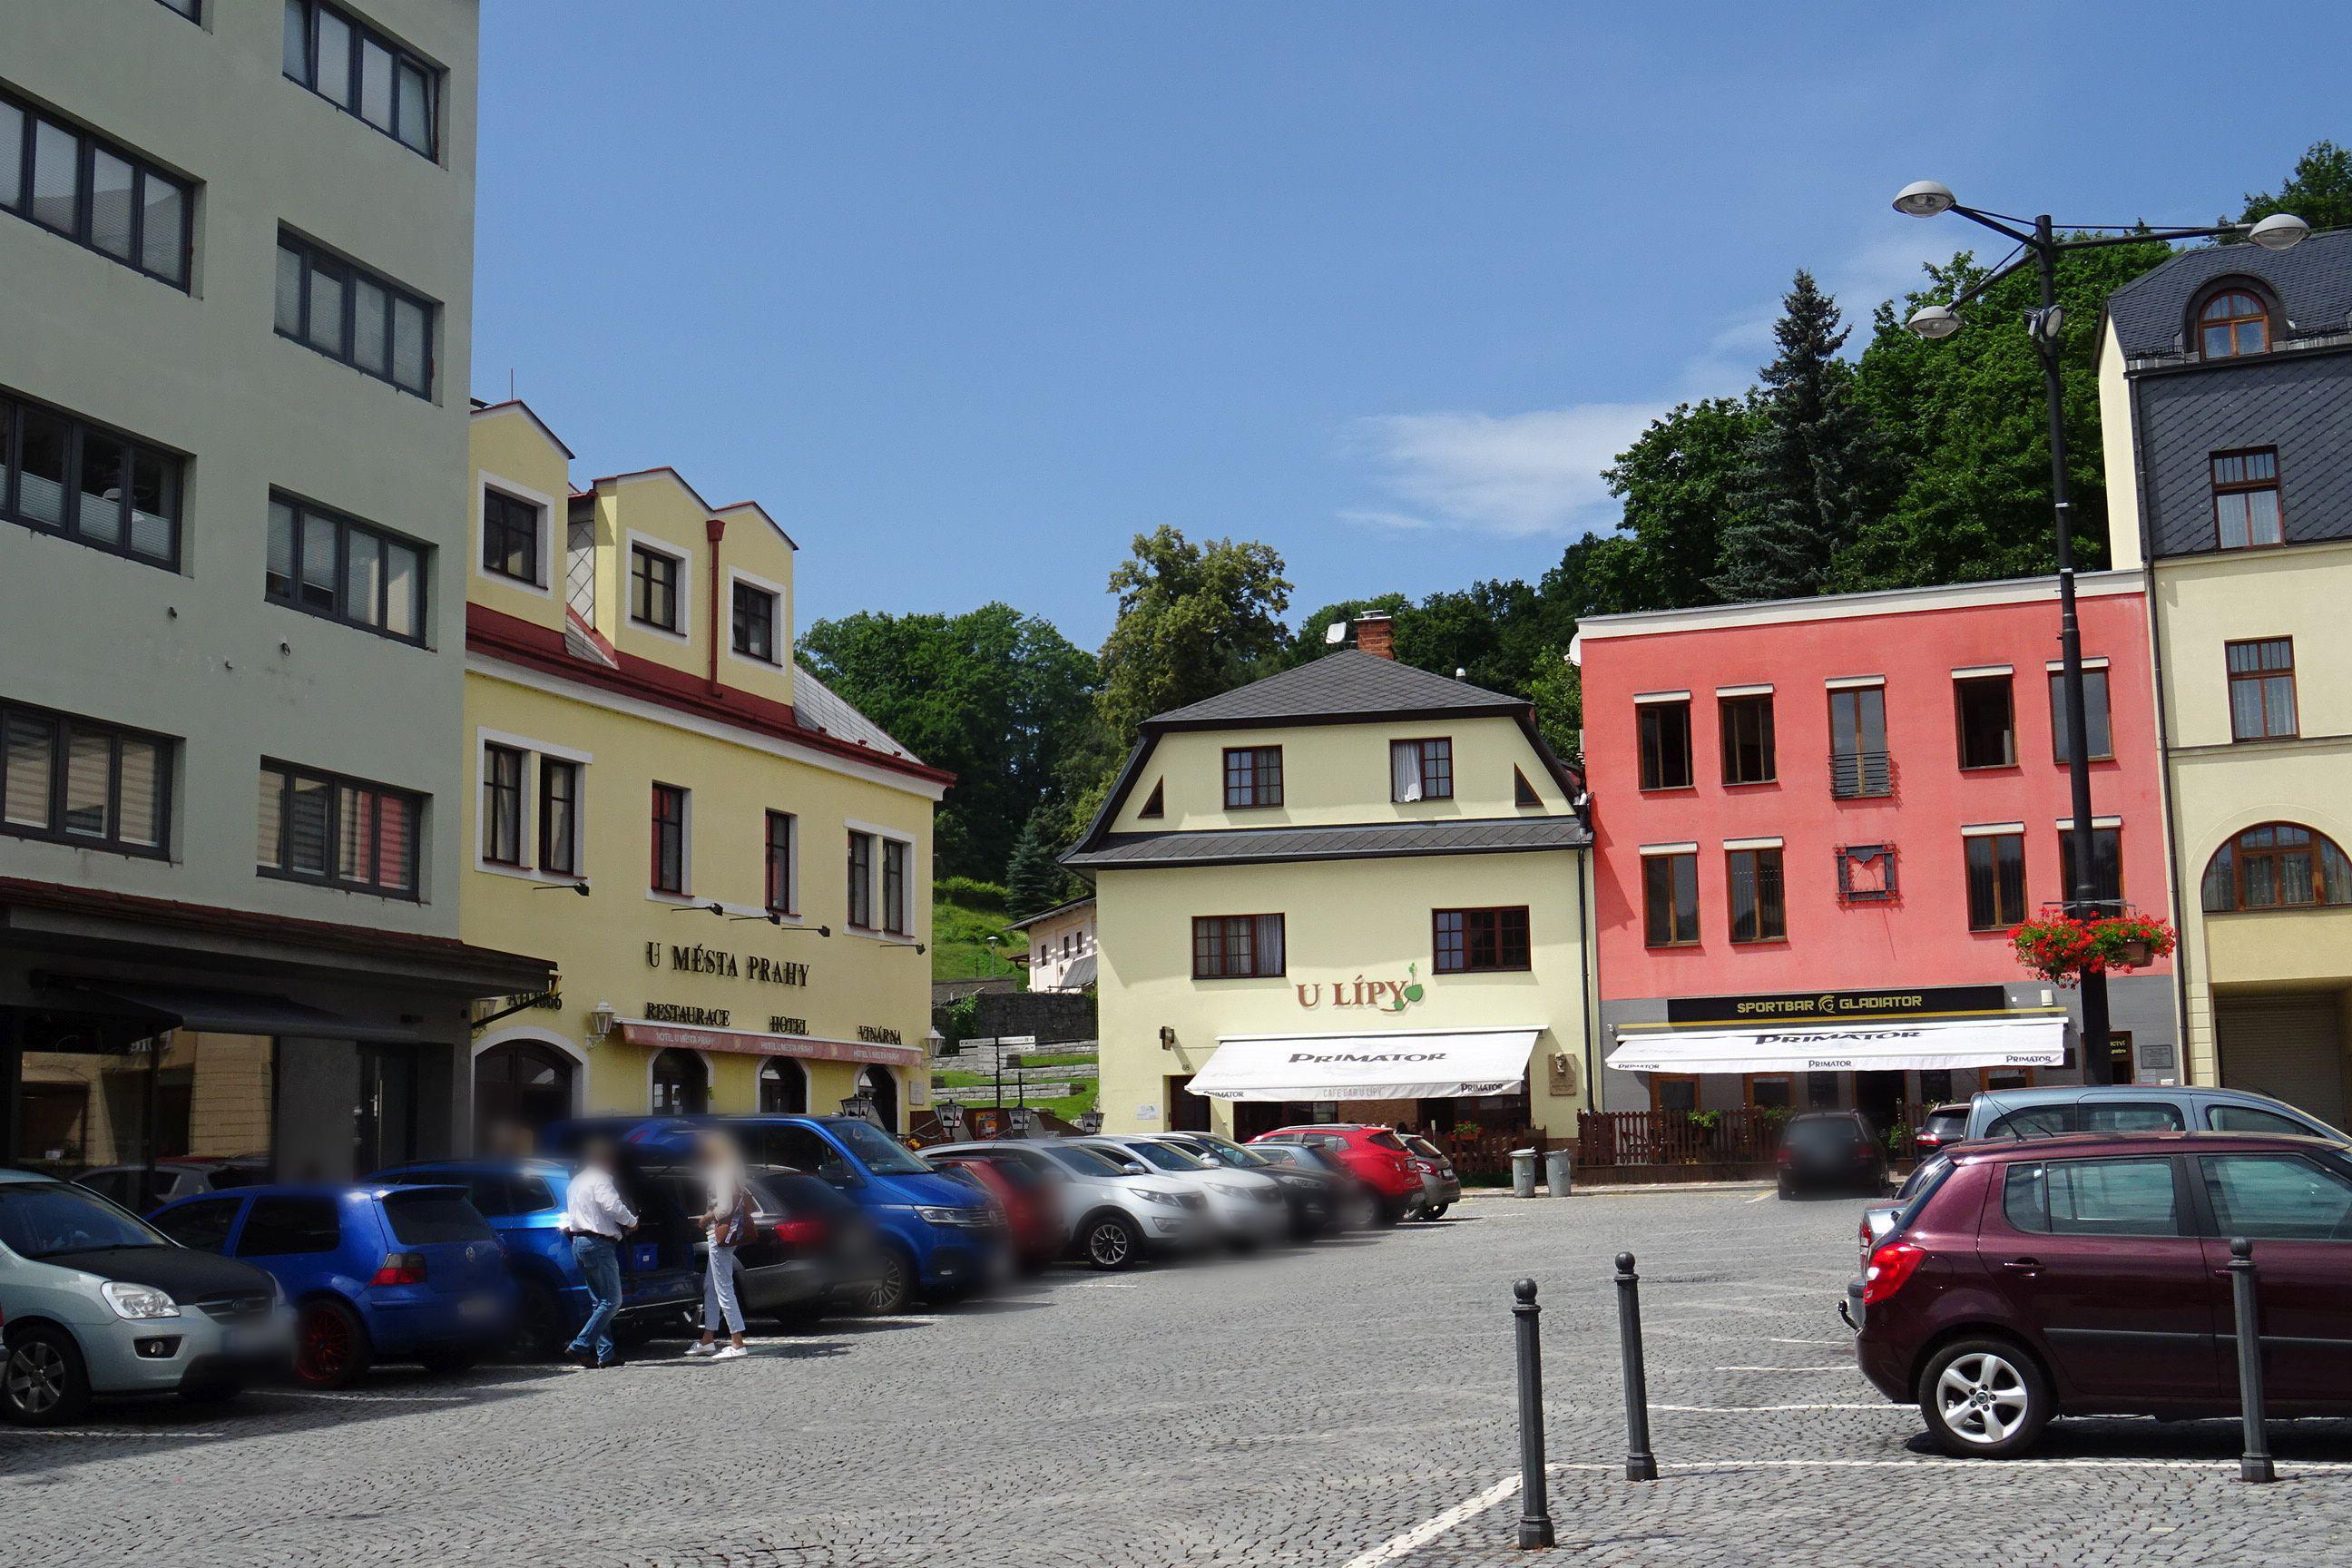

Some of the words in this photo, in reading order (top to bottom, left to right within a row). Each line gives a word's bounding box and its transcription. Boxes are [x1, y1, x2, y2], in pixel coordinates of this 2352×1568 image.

[646, 942, 661, 968] U
[747, 956, 810, 987] PRAHY
[1295, 983, 1321, 1007] U
[1331, 975, 1408, 1006] LÍPY
[1737, 1000, 1815, 1014] SPORTBAR
[1839, 995, 1923, 1010] GLADIATOR
[644, 1002, 730, 1027] RESTAURACE
[769, 1015, 809, 1036] HOTEL
[858, 1025, 902, 1045] VINÁRNA
[1754, 1032, 1922, 1045] PRIMATOR
[1288, 1053, 1447, 1063] PRIMATOR
[1808, 1060, 1852, 1068] PRIMATOR
[1460, 1083, 1504, 1093] PRIMATOR
